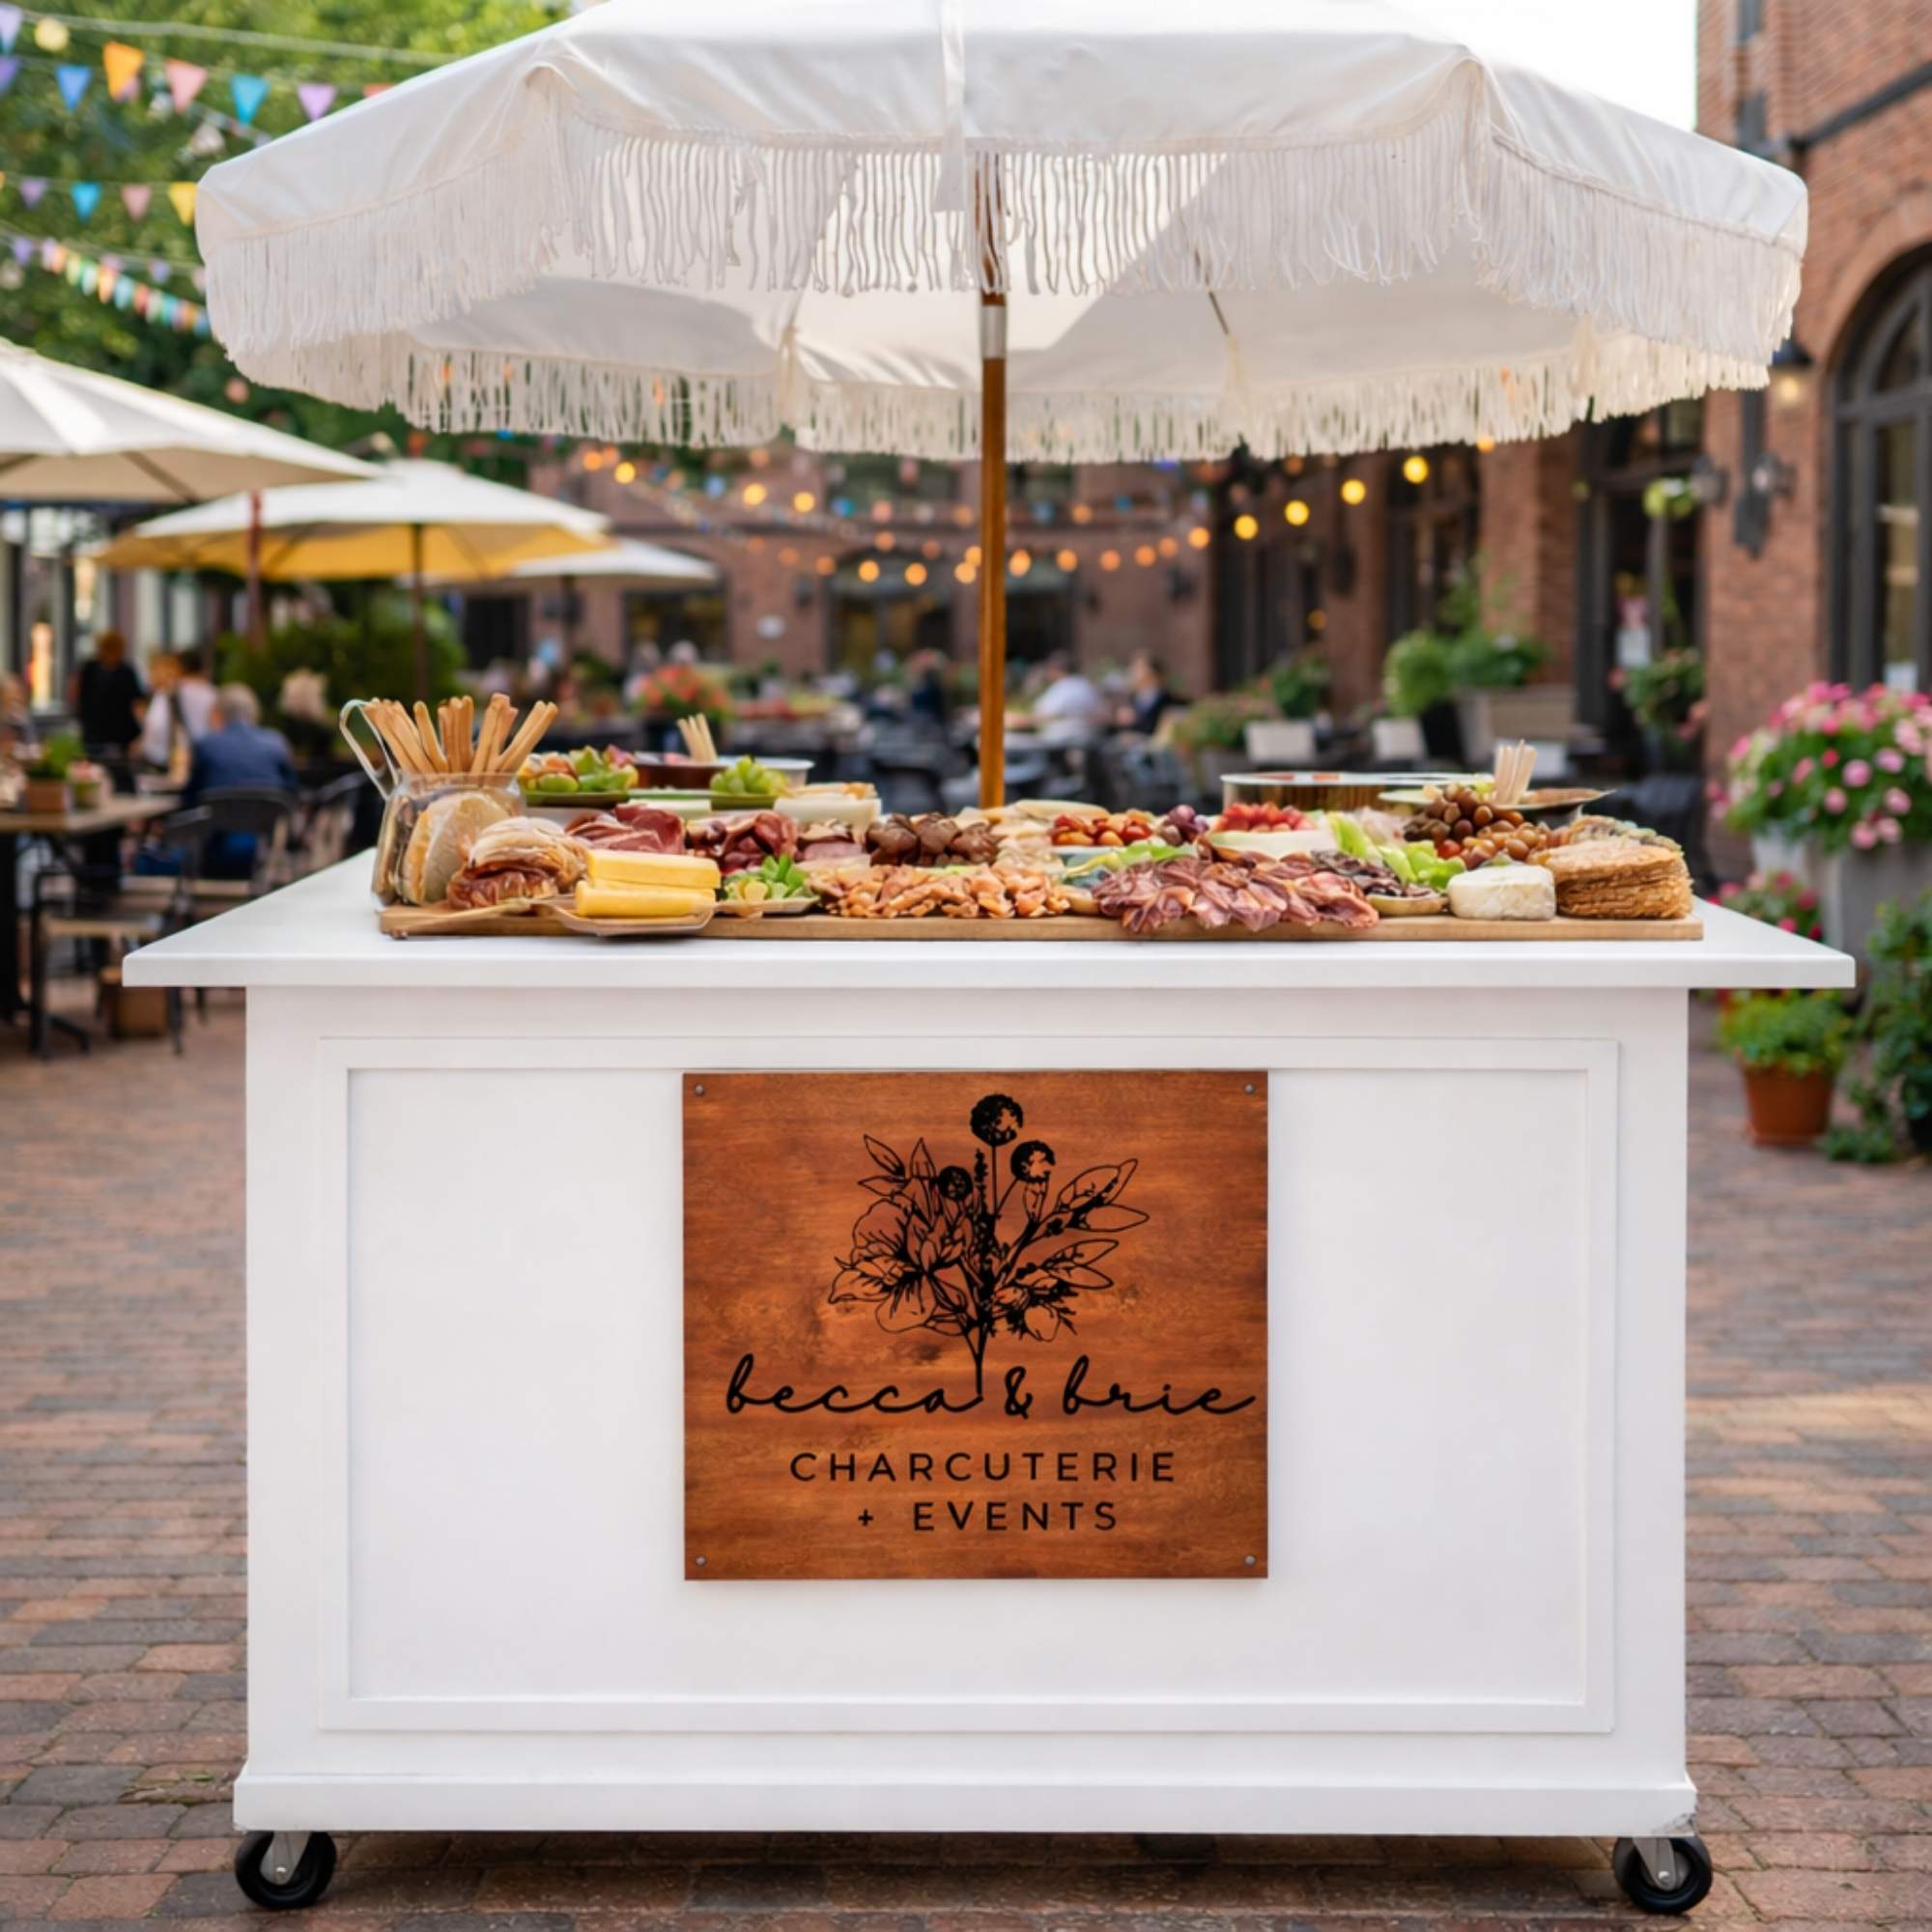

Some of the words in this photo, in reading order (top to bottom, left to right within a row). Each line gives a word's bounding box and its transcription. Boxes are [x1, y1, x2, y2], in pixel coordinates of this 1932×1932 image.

[725, 1353, 984, 1414] becca
[1004, 1366, 1034, 1419] &
[1062, 1354, 1256, 1415] brie
[790, 1452, 1175, 1482] CHARCUTERIE
[858, 1510, 874, 1526] +
[914, 1501, 1117, 1531] EVENTS
